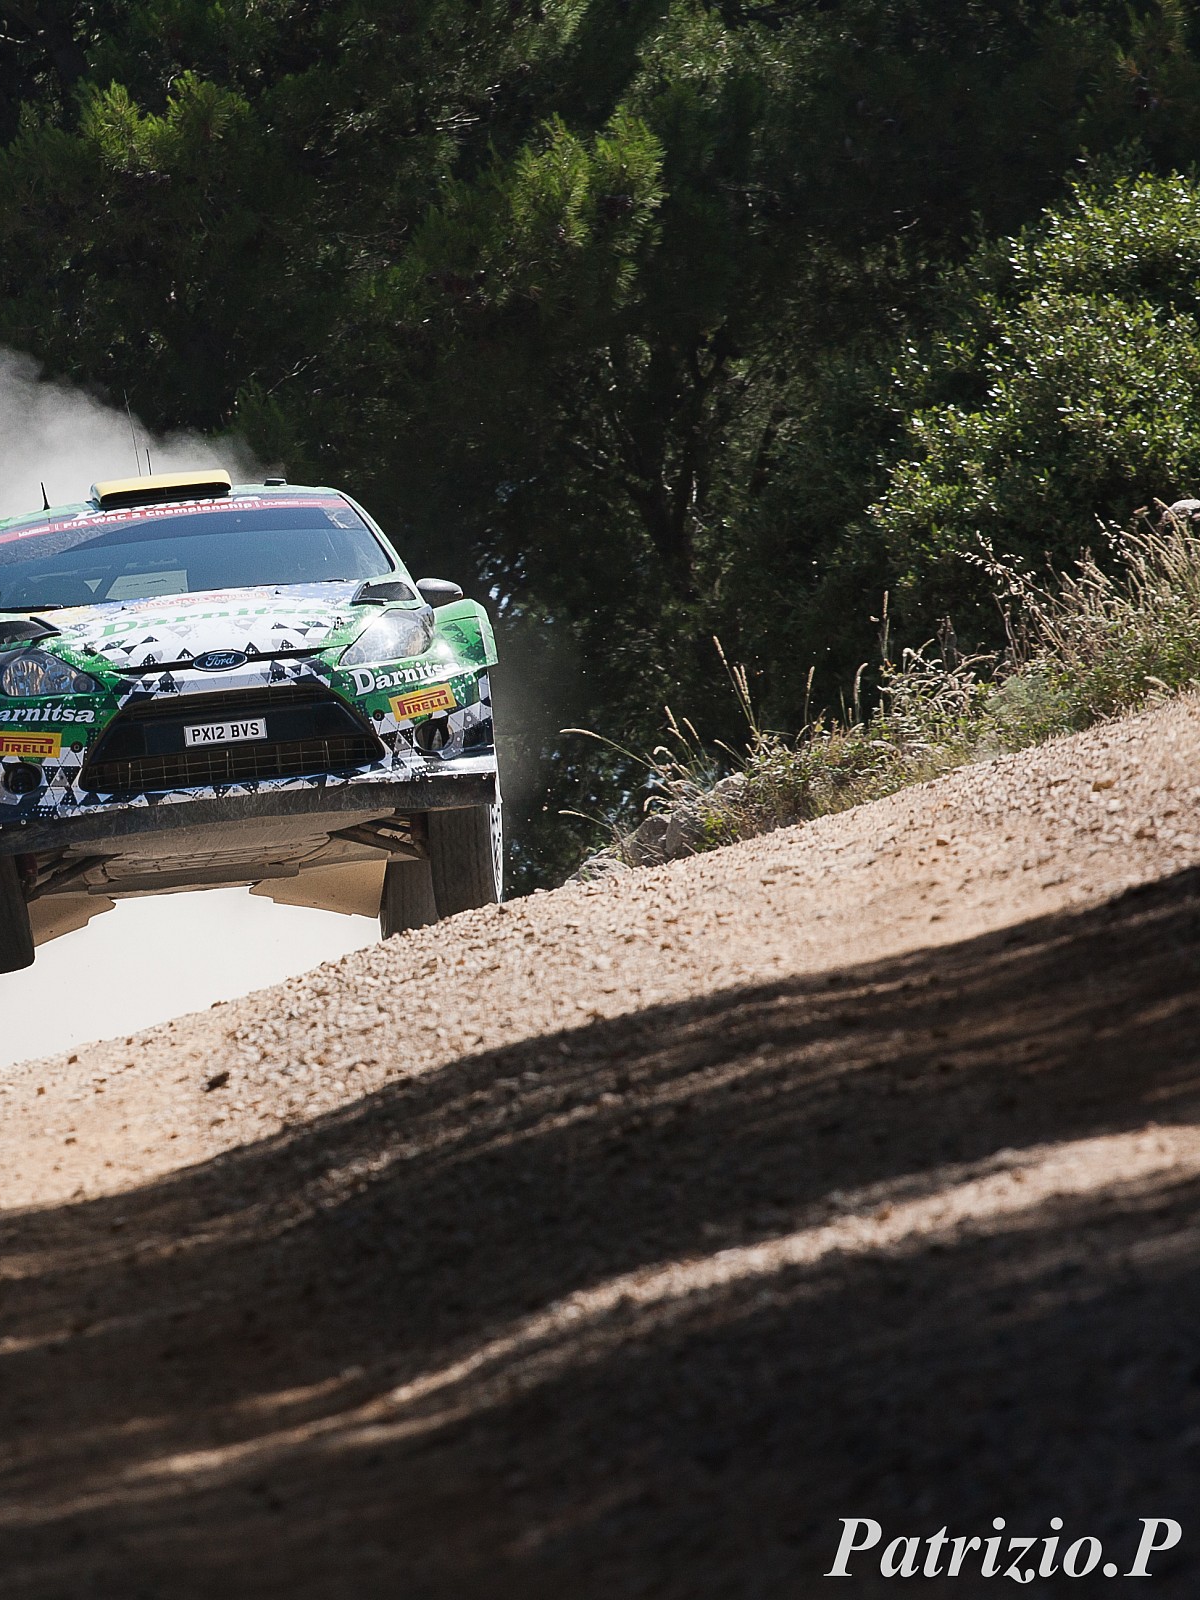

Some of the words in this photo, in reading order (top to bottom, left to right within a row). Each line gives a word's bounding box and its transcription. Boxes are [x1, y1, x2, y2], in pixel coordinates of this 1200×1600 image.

[63, 519, 89, 529] FIA
[99, 512, 127, 524] WRC
[146, 502, 252, 517] Championship
[205, 653, 235, 668] Ford
[397, 690, 449, 716] PIRELLI
[191, 727, 226, 742] PX12
[230, 722, 260, 738] BVS
